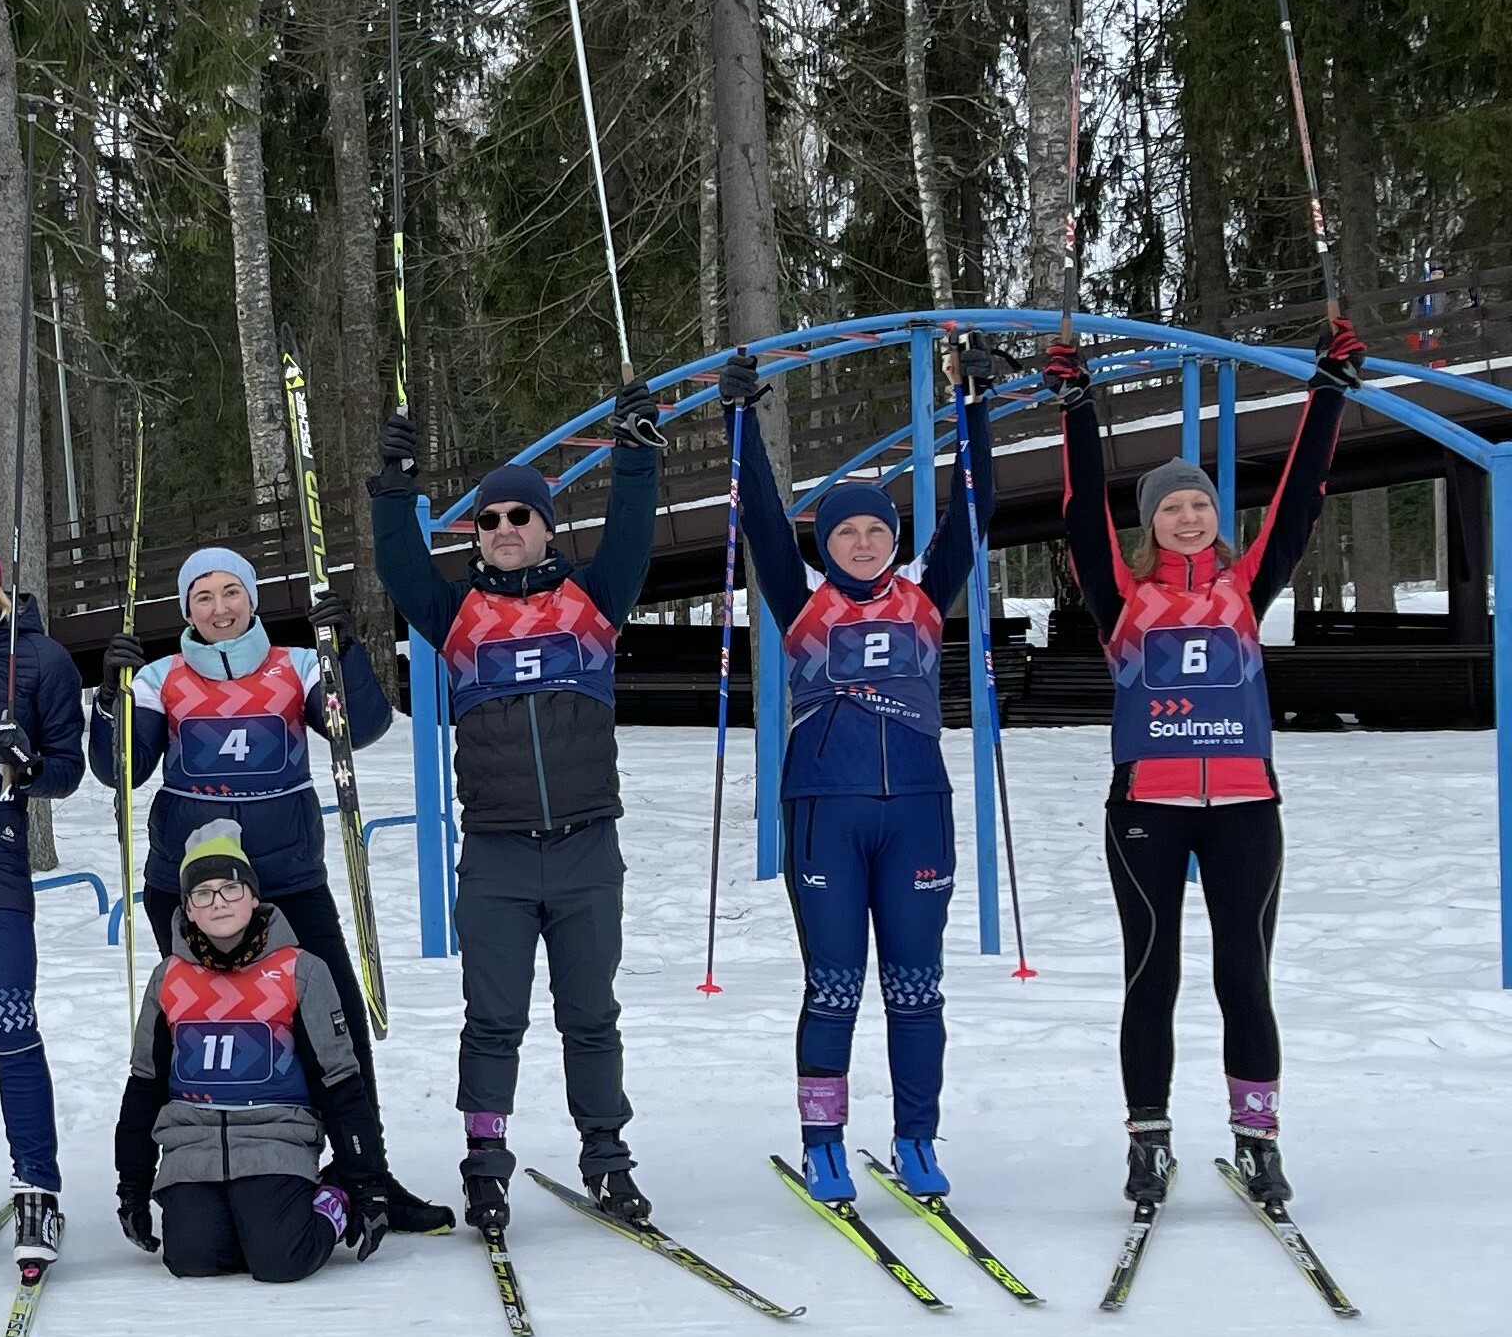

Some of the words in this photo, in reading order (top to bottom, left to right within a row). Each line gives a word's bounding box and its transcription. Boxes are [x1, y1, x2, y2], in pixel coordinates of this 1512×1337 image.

[295, 391, 314, 459] FISCHER
[730, 478, 739, 508] KV+
[515, 649, 541, 681] 5
[864, 633, 890, 667] 2
[1182, 639, 1208, 674] 6
[1149, 718, 1244, 738] Soulmate
[218, 729, 250, 761] 4
[802, 874, 827, 886] VC
[202, 1035, 235, 1070] 11
